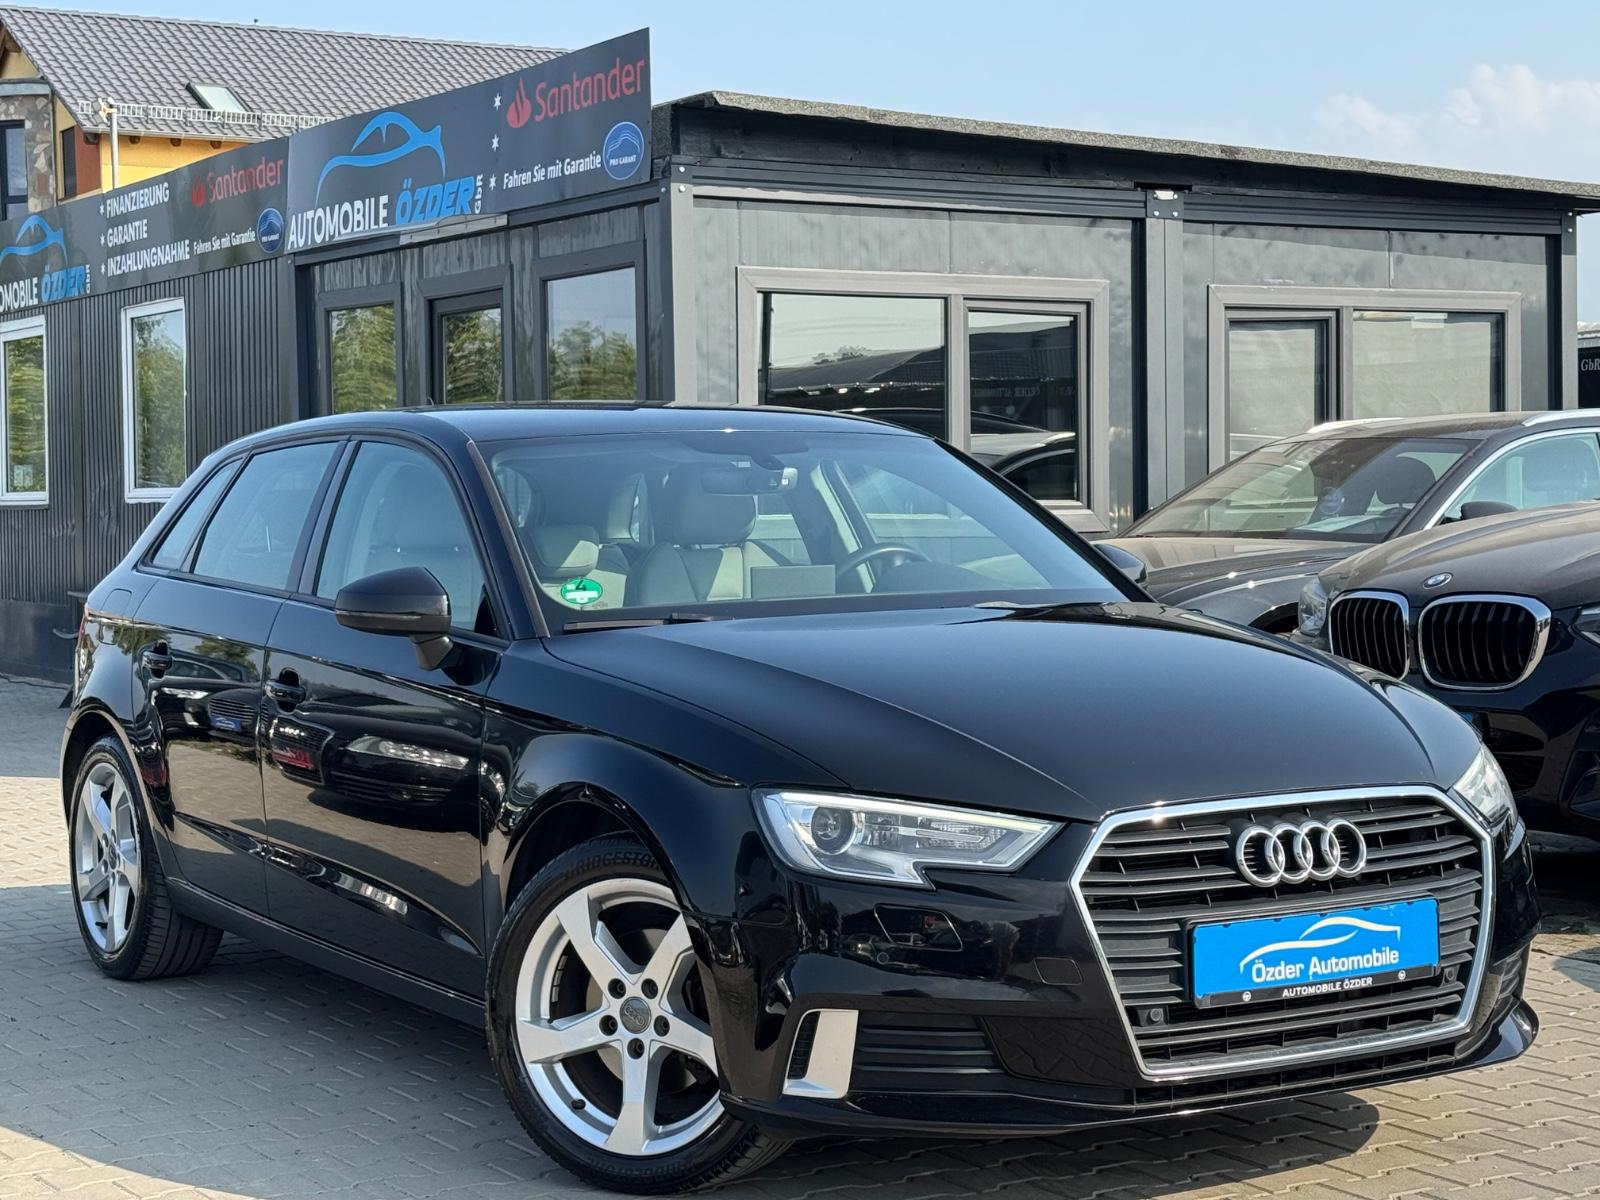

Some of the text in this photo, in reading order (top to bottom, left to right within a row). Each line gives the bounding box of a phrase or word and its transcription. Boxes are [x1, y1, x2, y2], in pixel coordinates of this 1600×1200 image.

[534, 57, 645, 122] Santander
[207, 157, 284, 203] Santander
[503, 150, 602, 189] Fahren Sie mit Garantie
[106, 182, 170, 219] FINANZIERUNG
[288, 176, 476, 249] AUTOMOBILE ÖZDER
[474, 174, 484, 214] GbR
[106, 219, 148, 248] GARANTIE
[107, 239, 190, 277] INZAHLUNGNAHME
[41, 264, 85, 303] ÖZDER
[576, 579, 587, 591] 4
[1252, 947, 1400, 983] Özder Automobile
[1282, 976, 1373, 998] AUTOMOBILE ÖZDER
